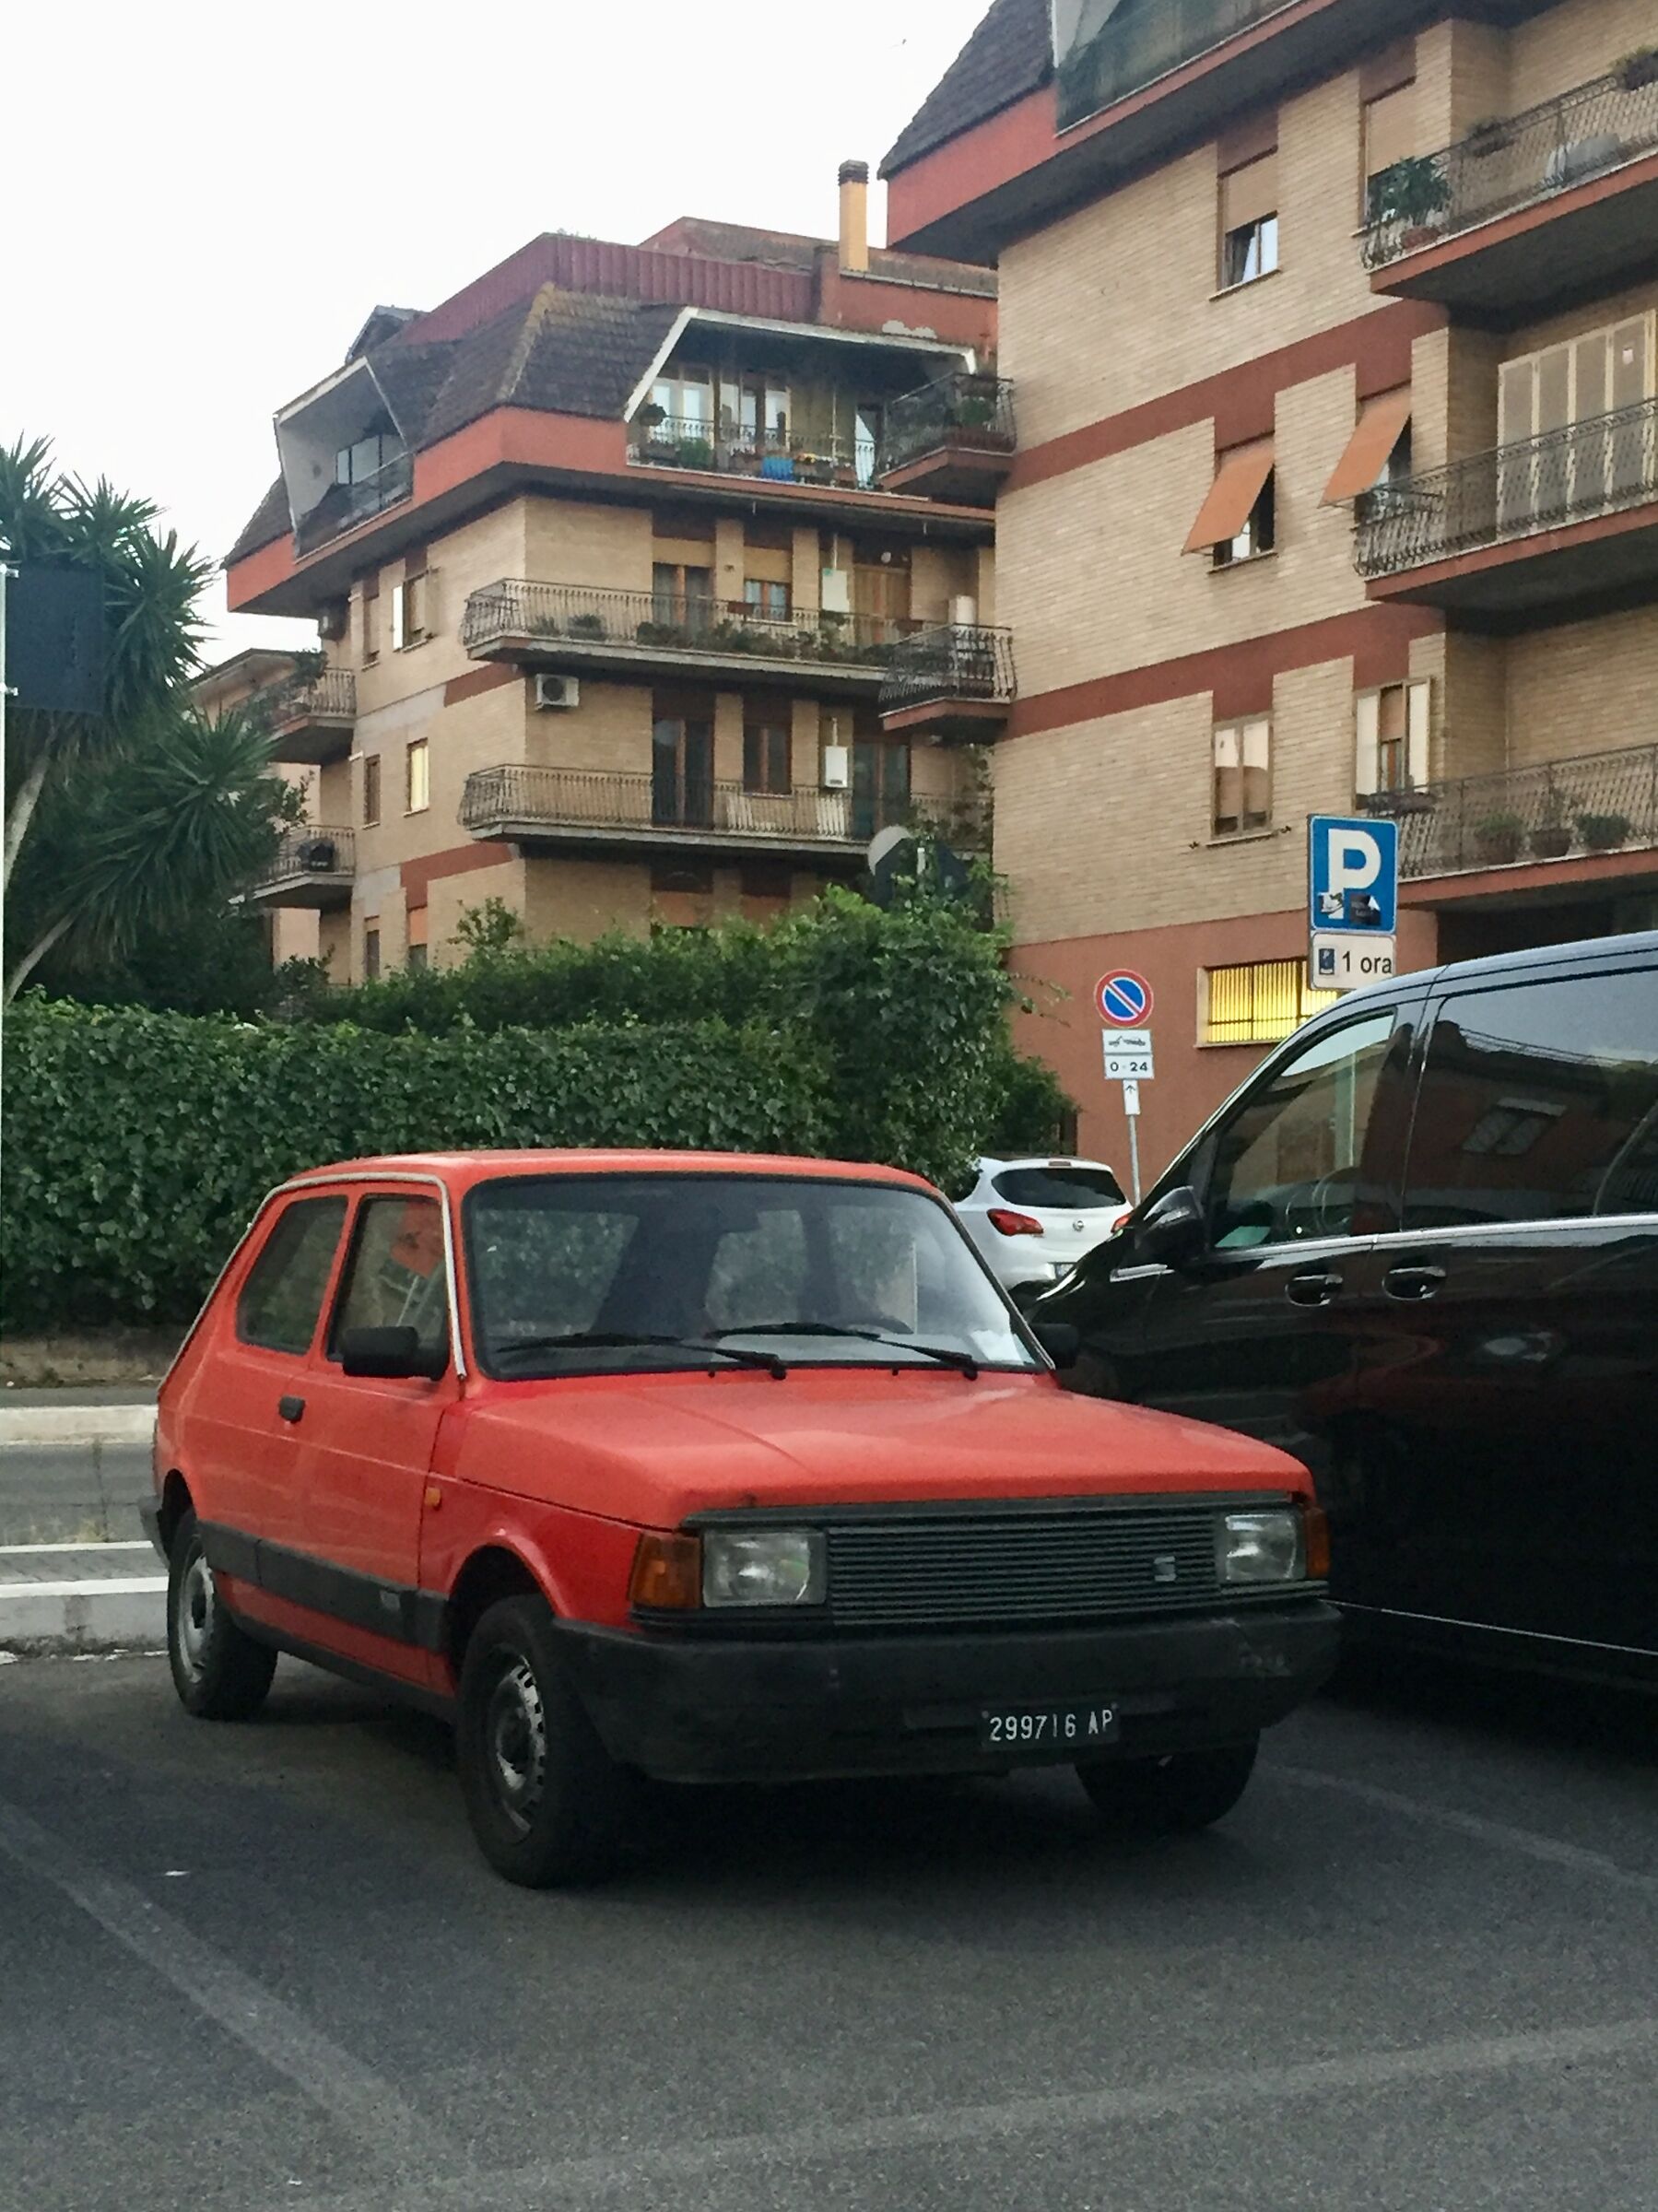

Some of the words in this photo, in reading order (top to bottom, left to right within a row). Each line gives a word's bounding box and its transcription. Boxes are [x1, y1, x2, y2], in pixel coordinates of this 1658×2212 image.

[1328, 829, 1382, 920] P
[1342, 950, 1351, 972] 1
[1360, 956, 1393, 974] ora
[1130, 1062, 1148, 1072] 24
[989, 1712, 1076, 1741] 299716
[1088, 1709, 1113, 1735] AP
